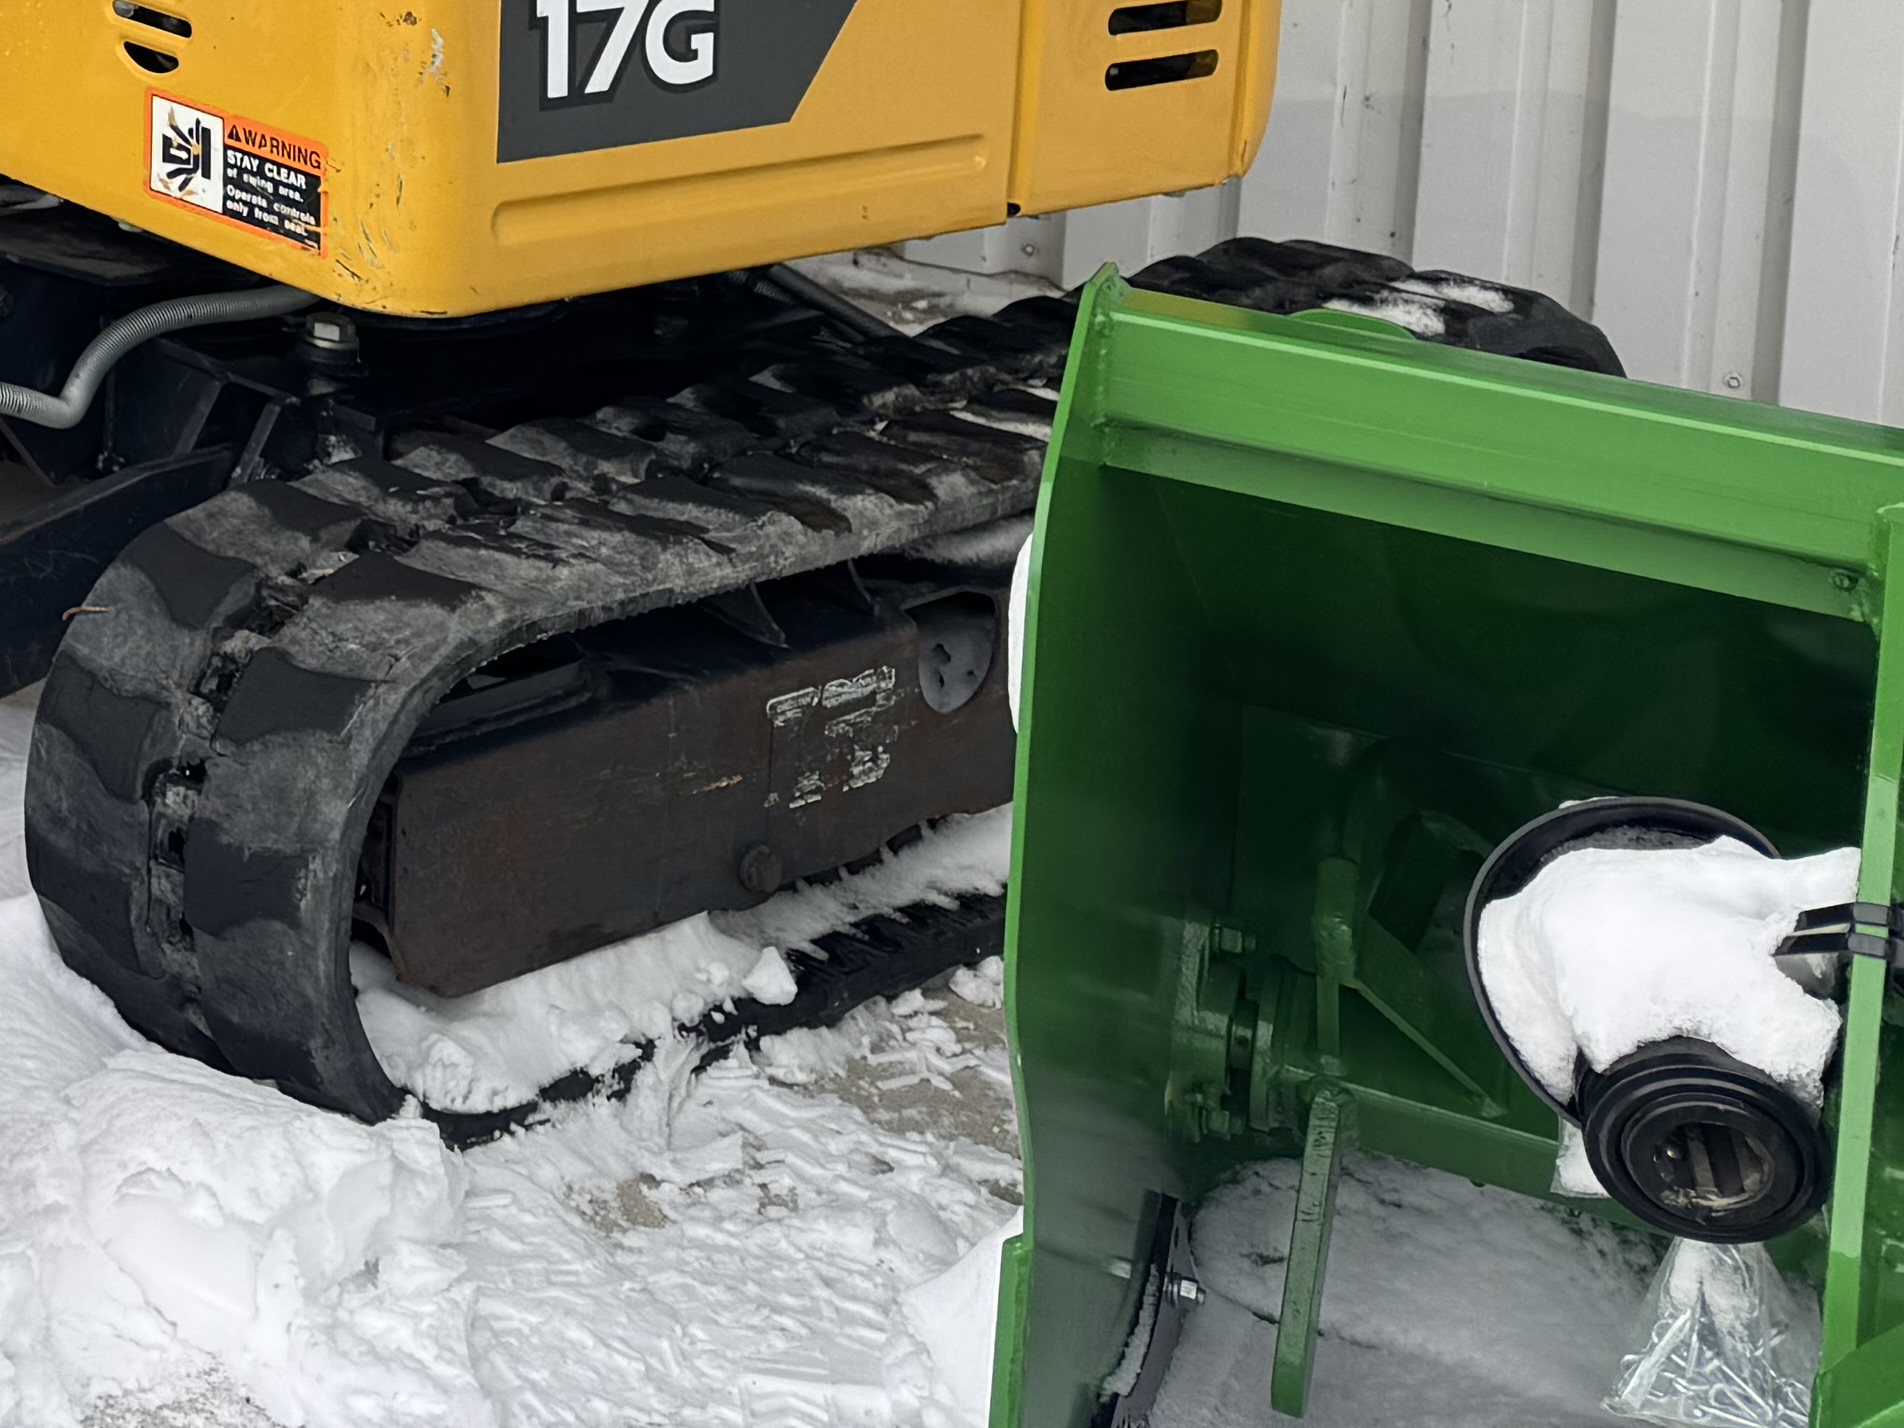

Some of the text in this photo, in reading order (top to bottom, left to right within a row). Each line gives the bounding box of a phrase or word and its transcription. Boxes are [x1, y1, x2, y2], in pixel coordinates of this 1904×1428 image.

[243, 127, 321, 170] WARNING
[226, 150, 307, 190] STAY CLEAR
[226, 184, 268, 208] Operate
[254, 208, 279, 225] from
